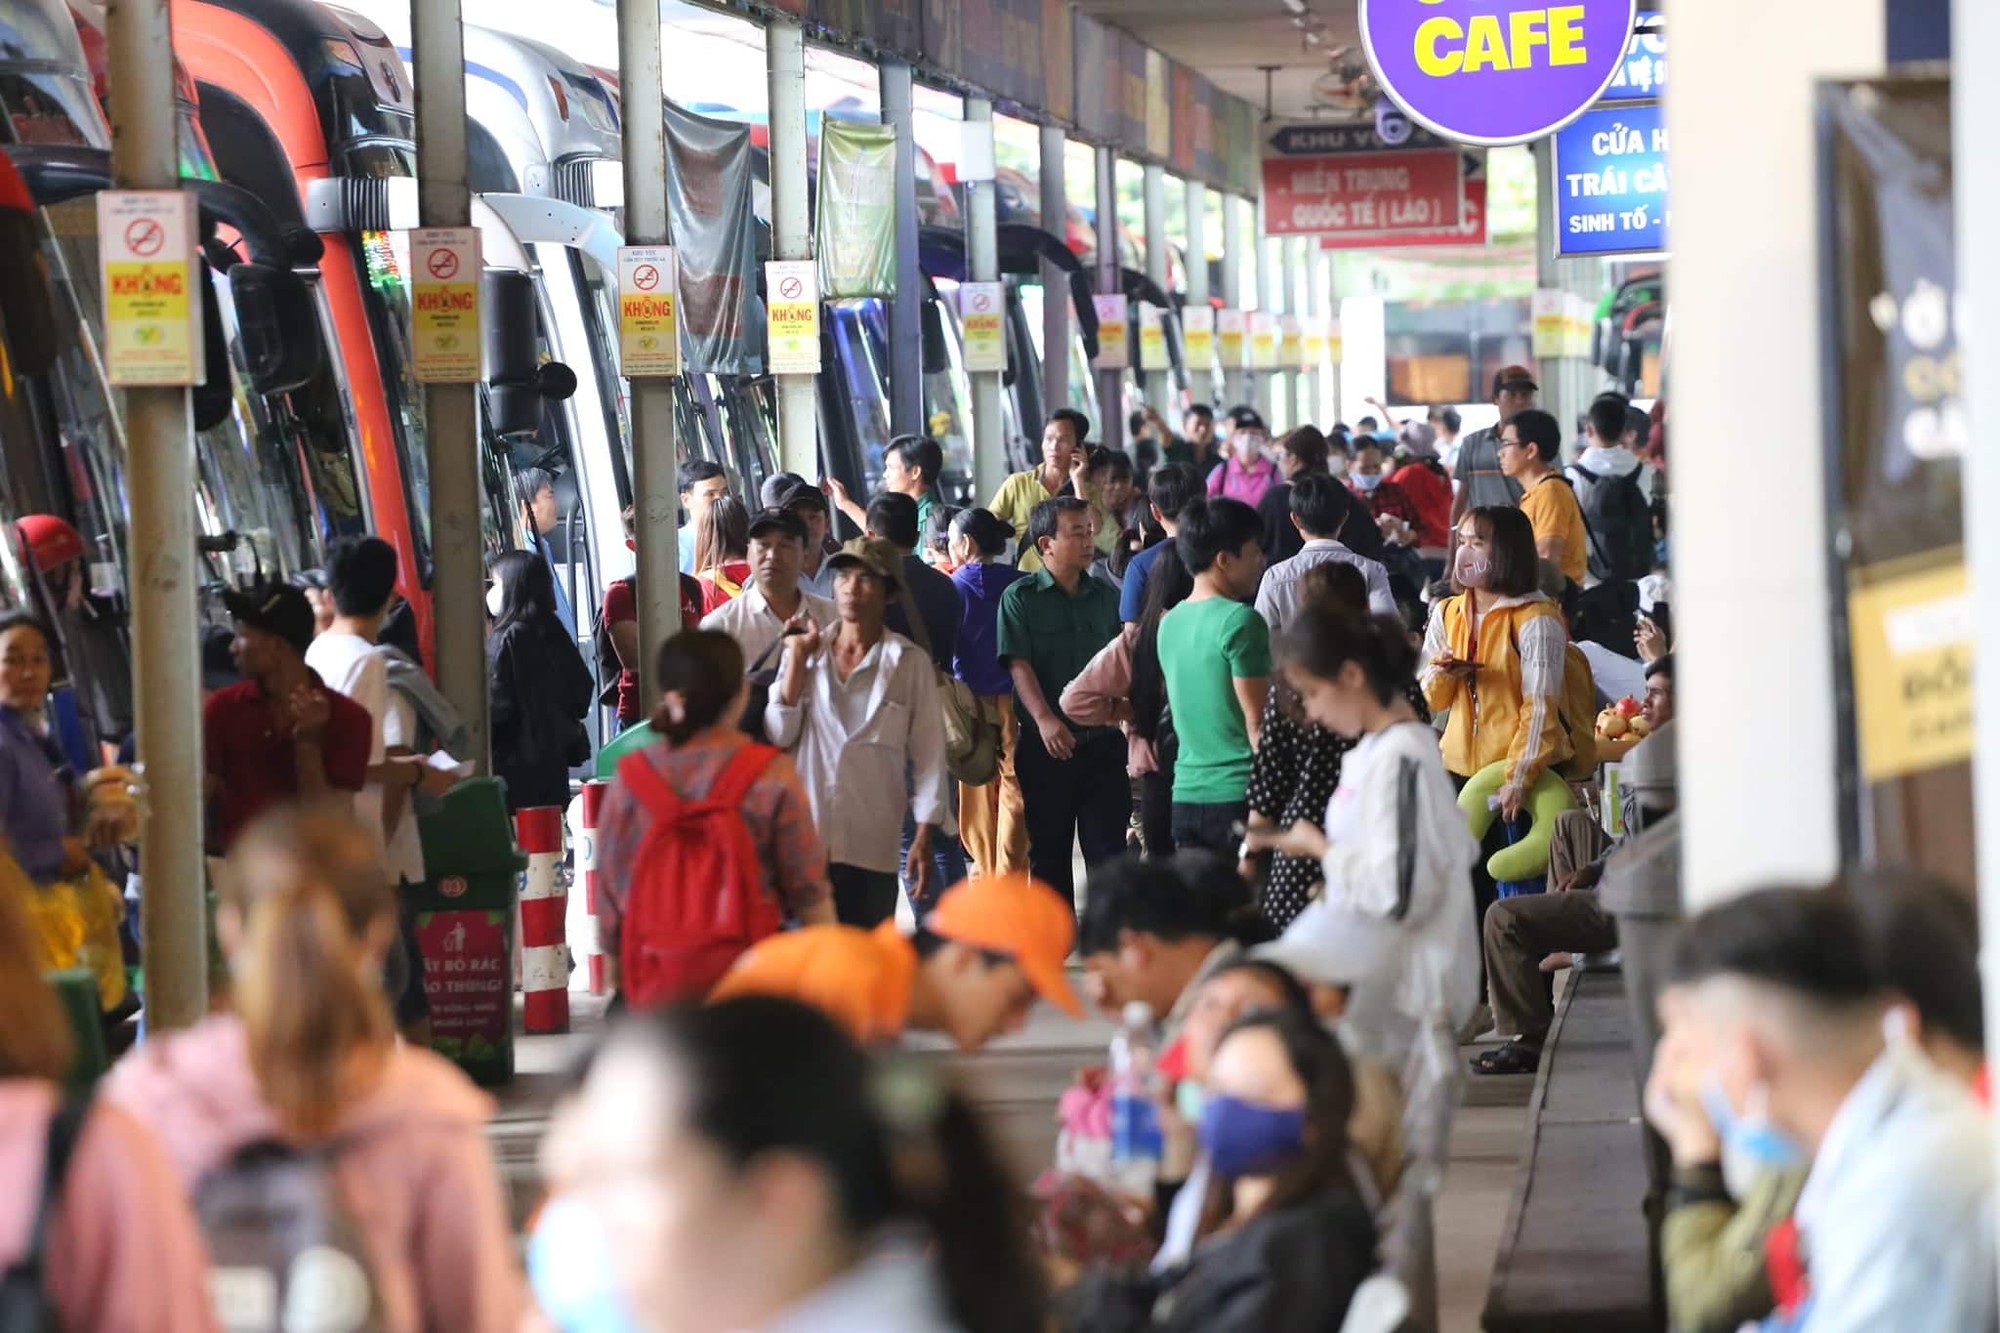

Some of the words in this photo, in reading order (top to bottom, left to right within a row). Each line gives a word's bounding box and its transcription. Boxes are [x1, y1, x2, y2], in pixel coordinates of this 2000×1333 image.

[1414, 5, 1587, 77] CAFE
[1592, 122, 1645, 156] CỬA
[1566, 165, 1627, 197] TRÁI
[1633, 162, 1670, 193] CÂ
[1569, 213, 1615, 234] SINH
[1620, 204, 1649, 231] TỐ
[417, 285, 473, 312] KHÔNG
[624, 296, 671, 318] KHÔNG
[772, 303, 812, 323] KHÔNG
